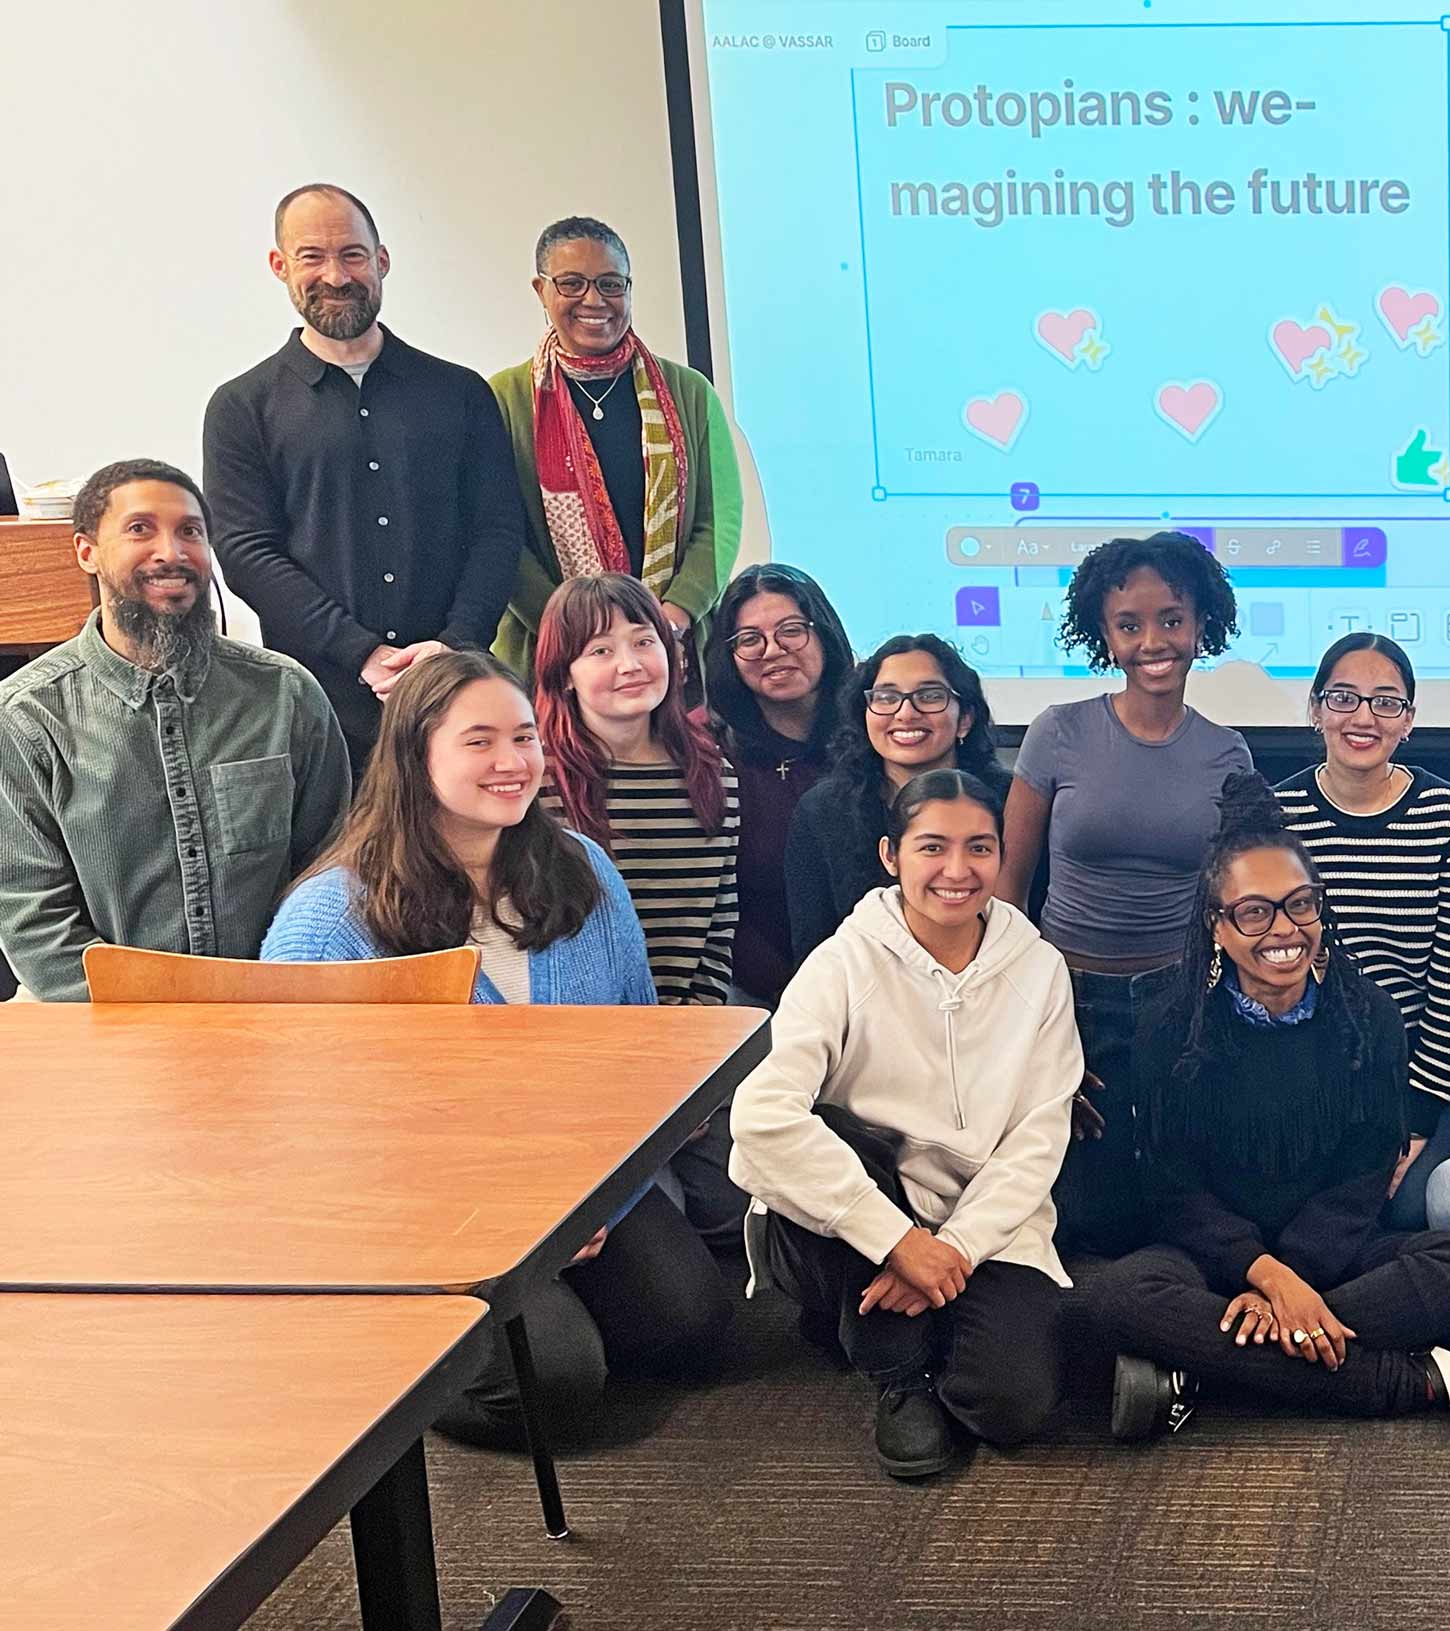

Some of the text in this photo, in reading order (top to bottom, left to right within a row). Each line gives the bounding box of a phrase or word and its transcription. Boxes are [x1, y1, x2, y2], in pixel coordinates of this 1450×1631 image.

[712, 35, 834, 49] AALAC @ VASSAR
[892, 35, 931, 47] Board
[884, 79, 1173, 138] Protopians
[1214, 89, 1317, 125] we-
[891, 168, 1411, 228] magining the future
[905, 447, 963, 462] Tamara
[1019, 488, 1030, 504] 7
